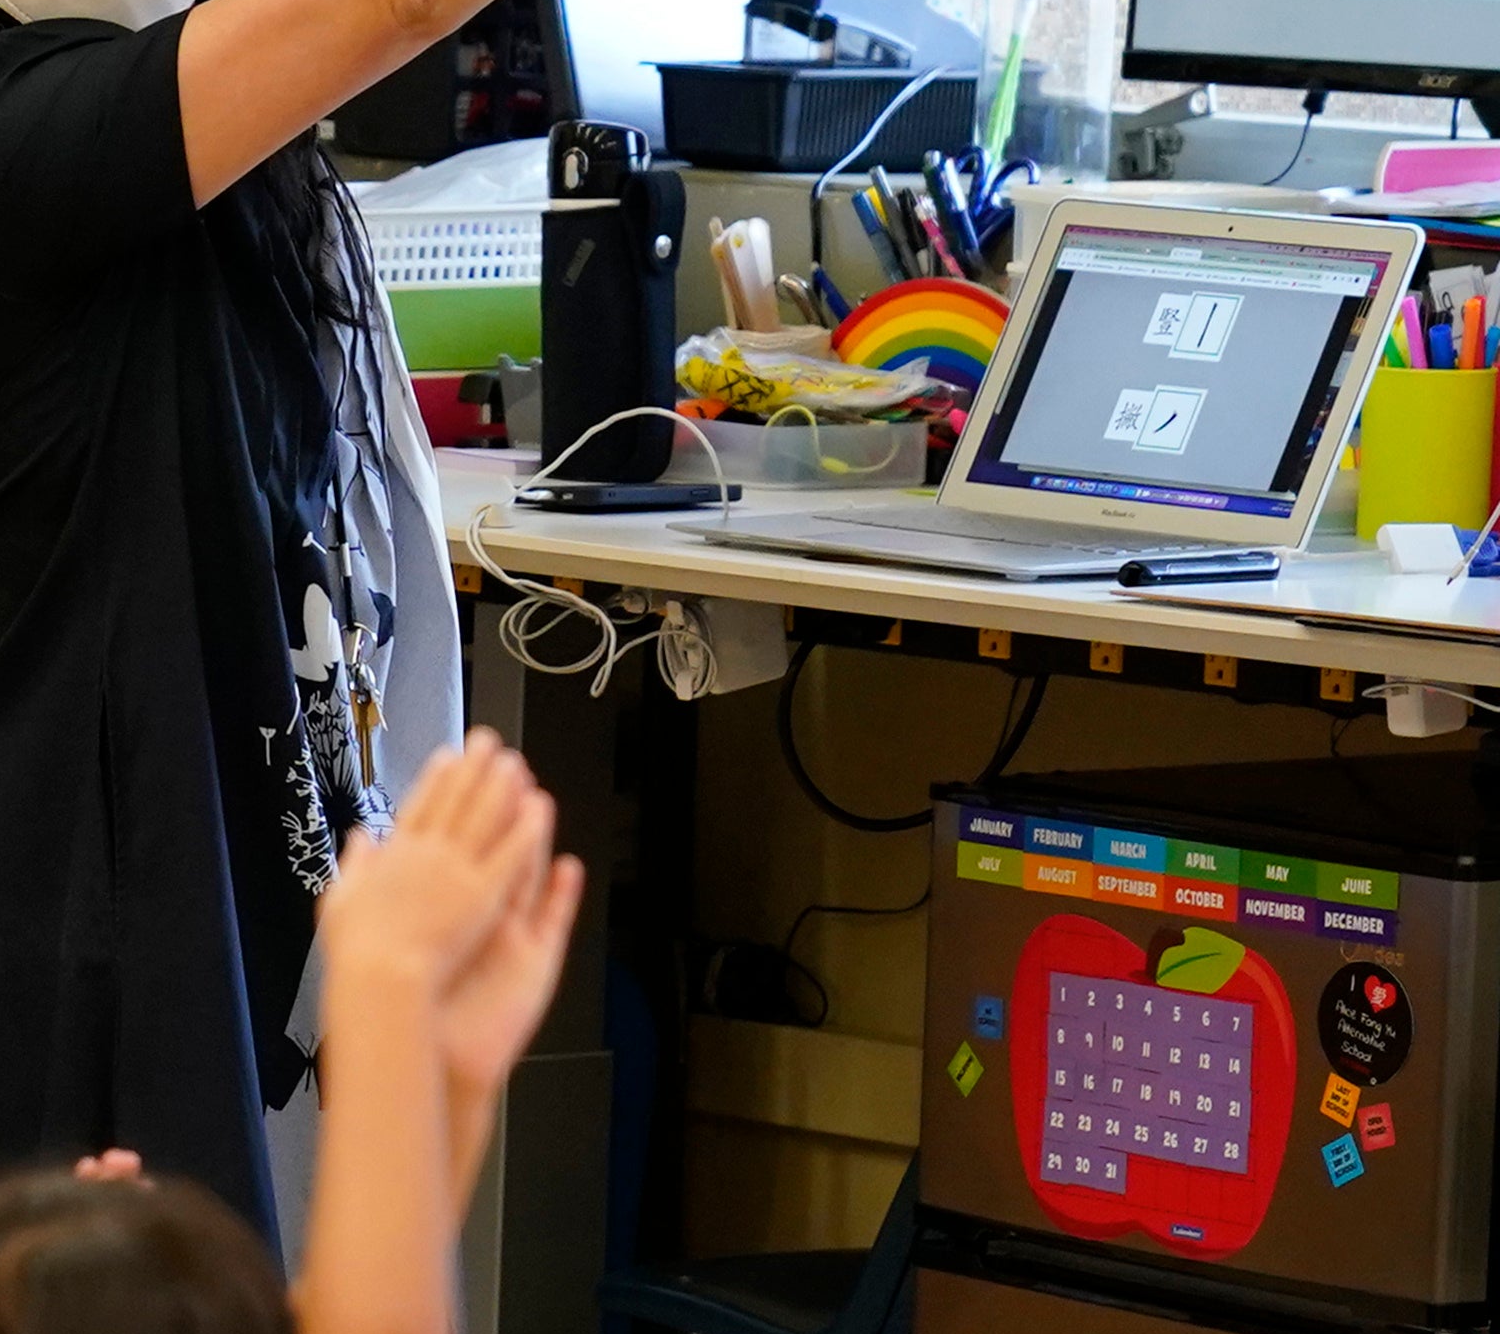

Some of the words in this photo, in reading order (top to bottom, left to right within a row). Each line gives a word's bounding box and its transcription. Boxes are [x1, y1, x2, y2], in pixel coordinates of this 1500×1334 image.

[970, 818, 1013, 837] JANUARY
[1034, 828, 1083, 849] FEBRUARY
[1111, 841, 1146, 859] MARCH
[1186, 852, 1216, 870] APRIL
[1266, 865, 1289, 881] MAY
[1342, 878, 1371, 894] JUNE
[978, 856, 1001, 871] JULY
[1038, 866, 1076, 884] AUGUST
[1098, 876, 1157, 898] SEPTEMBER
[1176, 889, 1224, 909] OCTOBER
[1246, 899, 1305, 921] NOVEMBER
[1324, 912, 1384, 934] DECEMBER
[1061, 987, 1065, 1001] 1
[1088, 991, 1095, 1006] 2
[1116, 994, 1123, 1009] 3
[1144, 1001, 1152, 1015] 4
[1172, 1005, 1181, 1023] 5
[1202, 1011, 1210, 1026] 6
[1233, 1017, 1240, 1031] 7
[1336, 999, 1356, 1021] Alice
[1361, 1012, 1381, 1038] Fong
[1057, 1029, 1064, 1044] 8
[1085, 1033, 1093, 1047] 9
[1112, 1036, 1123, 1051] 10
[1142, 1042, 1150, 1057] 11
[1170, 1048, 1181, 1063] 12
[1199, 1054, 1210, 1069] 13
[1229, 1059, 1240, 1074] 14
[1338, 1021, 1386, 1051] Alternative
[1341, 1041, 1371, 1062] School
[1055, 1070, 1066, 1085] 15
[1084, 1074, 1094, 1090] 16
[1112, 1078, 1123, 1093] 17
[1141, 1085, 1151, 1100] 18
[1169, 1090, 1180, 1105] 19
[1197, 1095, 1212, 1112] 20
[1229, 1101, 1240, 1117] 21
[1050, 1112, 1064, 1128] 22
[1078, 1115, 1091, 1131] 23
[1106, 1119, 1119, 1135] 24
[1134, 1125, 1148, 1142] 25
[1164, 1131, 1178, 1148] 26
[1194, 1138, 1208, 1153] 27
[1224, 1142, 1239, 1158] 28
[1048, 1153, 1061, 1169] 29
[1076, 1156, 1090, 1173] 30
[1106, 1163, 1116, 1178] 31
